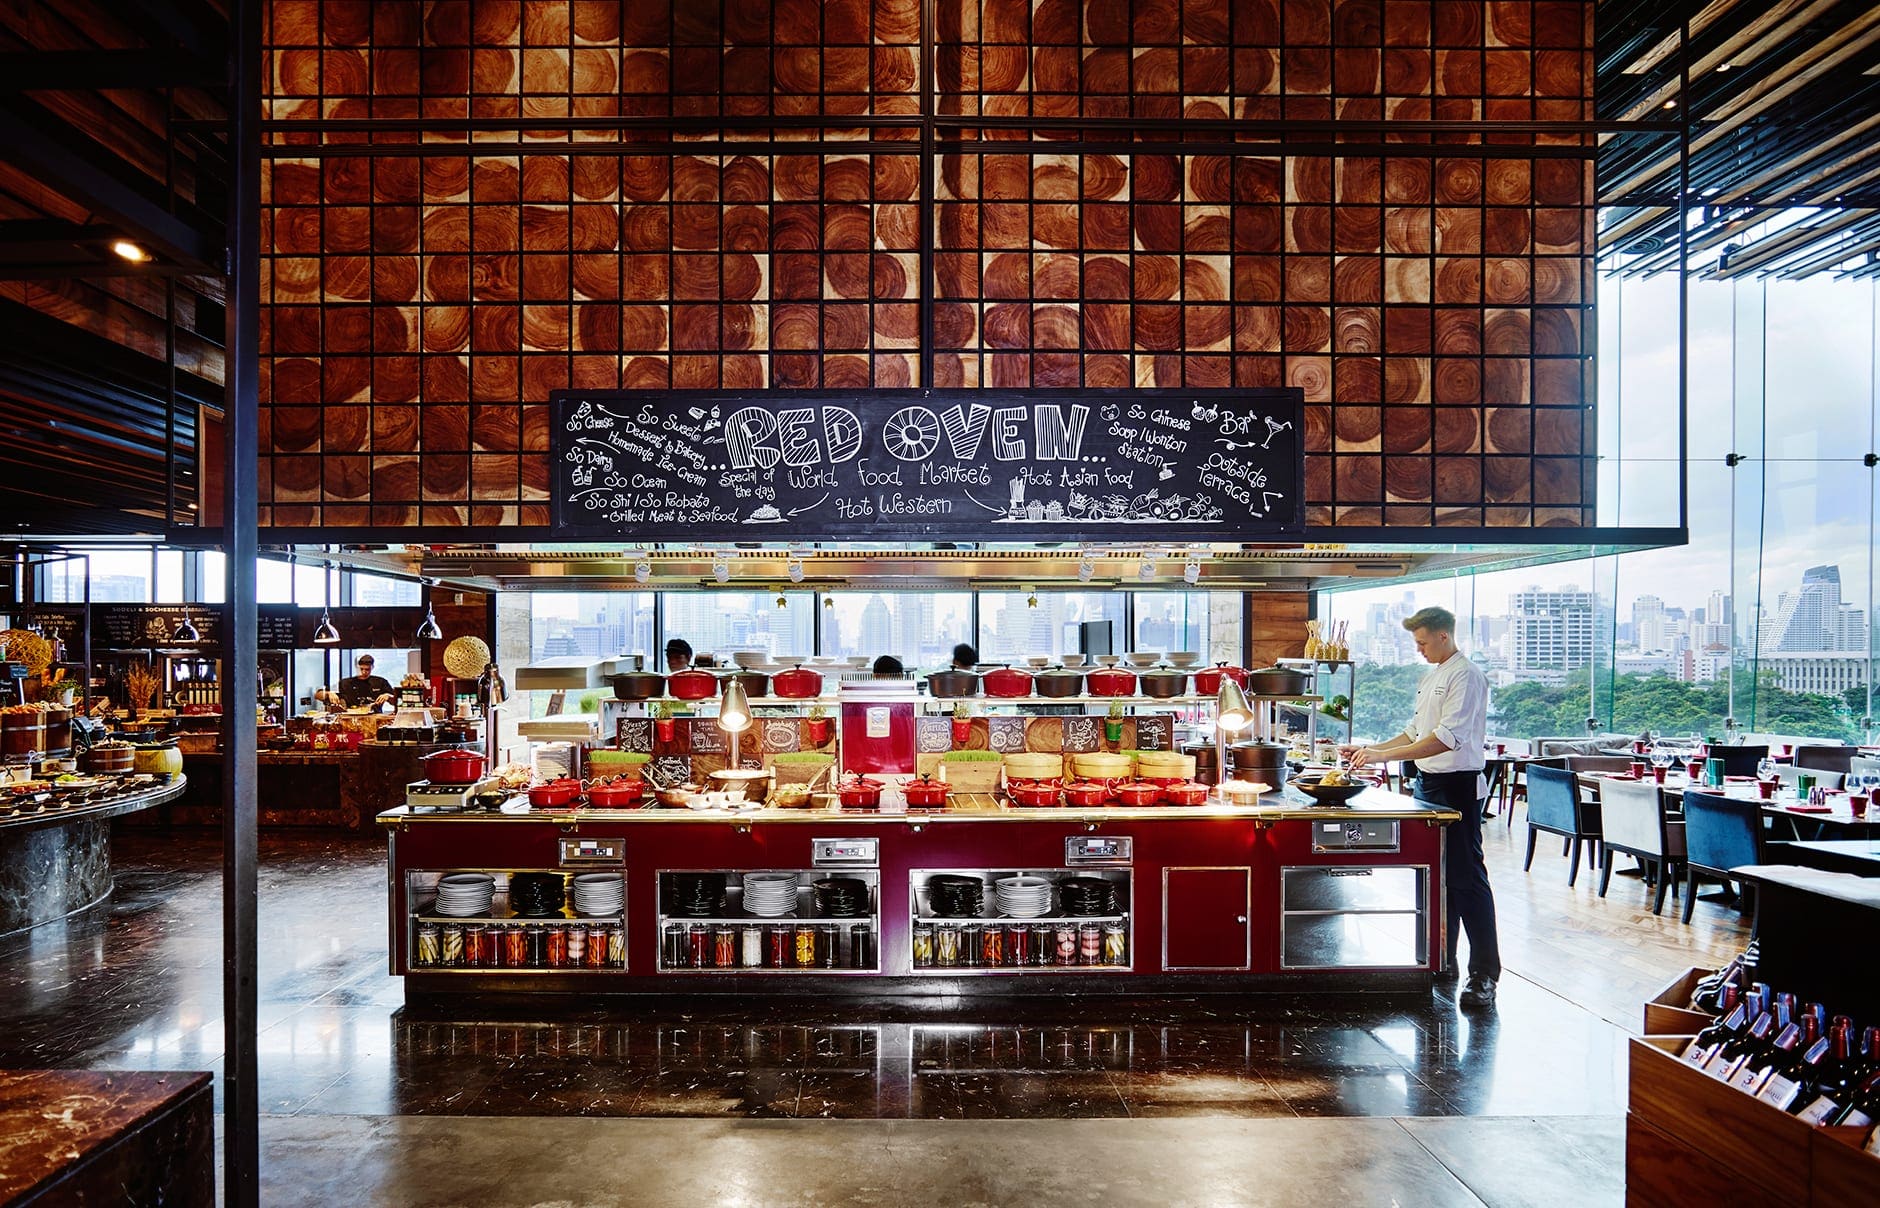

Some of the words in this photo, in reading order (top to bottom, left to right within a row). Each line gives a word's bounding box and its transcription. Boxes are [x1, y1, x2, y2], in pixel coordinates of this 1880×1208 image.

[566, 414, 582, 432] So
[637, 404, 659, 425] So
[663, 413, 702, 441] Sweet
[1127, 404, 1147, 420] So
[1150, 409, 1191, 432] Chinese
[1219, 410, 1253, 435] Bar
[626, 421, 667, 449] Dessert
[664, 440, 674, 454] &
[724, 405, 863, 470] RED
[566, 446, 585, 464] So
[587, 450, 614, 472] Dairy
[607, 430, 655, 463] Homemade
[655, 454, 707, 488] Ice-Cream
[1117, 442, 1164, 468] Station
[604, 471, 628, 488] So
[631, 473, 667, 489] Ocean
[718, 468, 757, 489] Special
[763, 467, 776, 483] of
[787, 464, 839, 489] World
[919, 461, 993, 485] Market
[1018, 466, 1053, 487] Hot
[1059, 466, 1099, 487] Asian
[1196, 463, 1250, 504] Terrace
[1208, 453, 1268, 488] Outside
[584, 492, 608, 510] So
[665, 491, 710, 510] Robata
[734, 486, 752, 499] the
[755, 485, 776, 501] day
[835, 496, 874, 519] Hot
[879, 493, 952, 514] Western
[649, 509, 675, 523] Meat
[677, 510, 687, 523] &
[688, 506, 739, 524] Seafood
